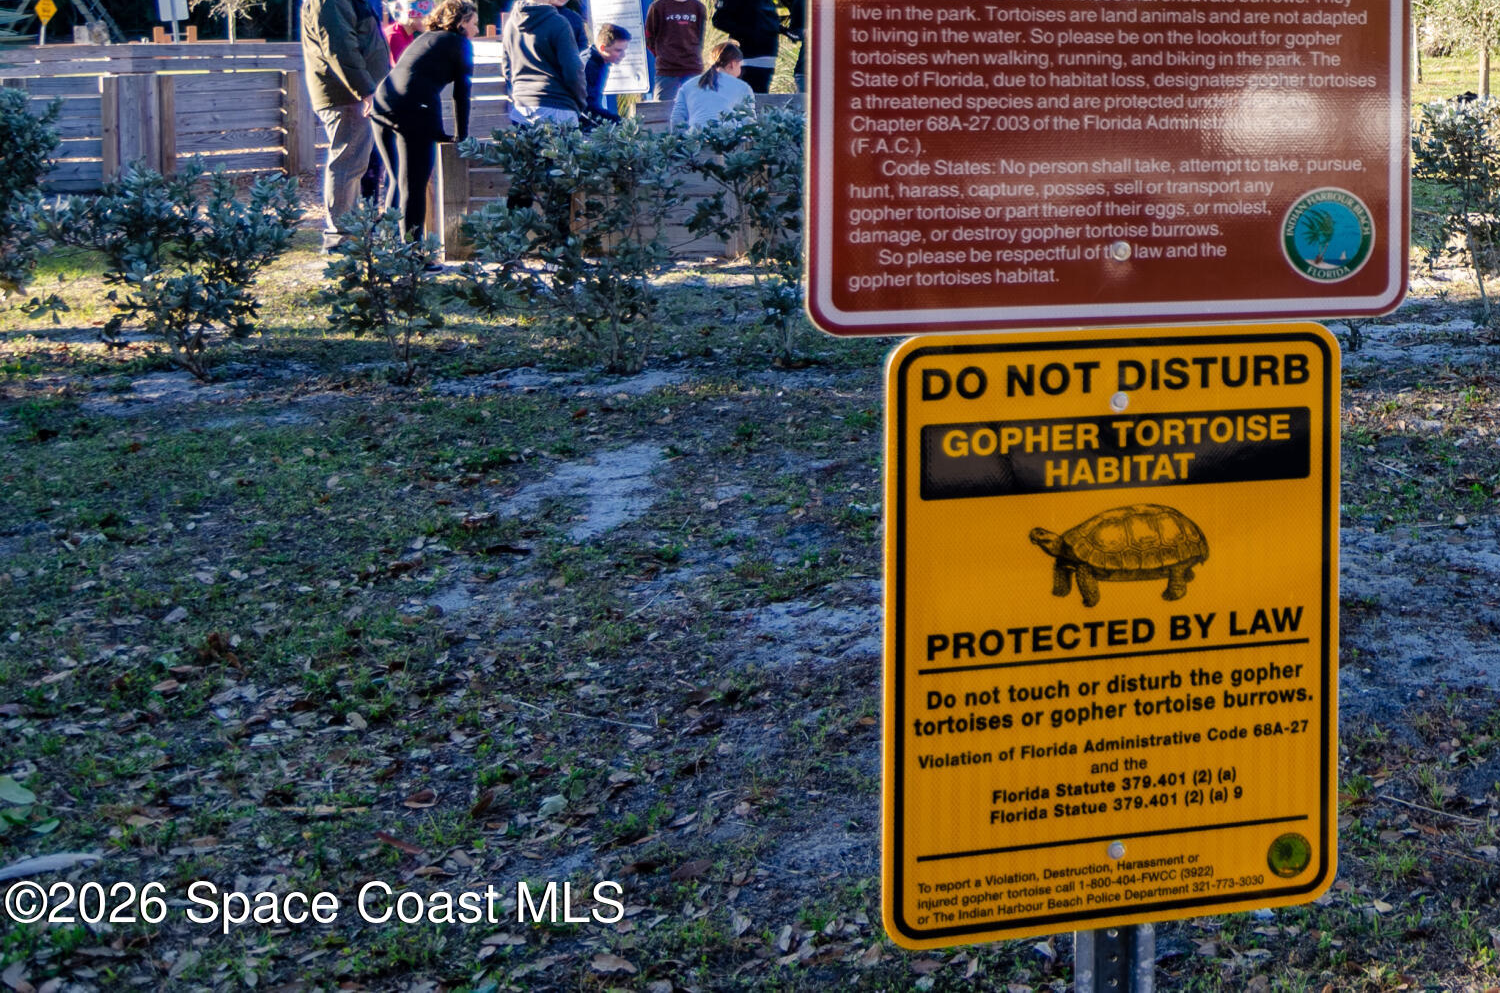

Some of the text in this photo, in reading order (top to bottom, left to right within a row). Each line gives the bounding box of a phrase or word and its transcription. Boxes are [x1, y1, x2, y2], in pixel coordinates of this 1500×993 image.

[849, 267, 1059, 292] gopher tortoises habitat.
[1306, 266, 1351, 279] FLORIDA
[922, 354, 1310, 401] DO NOT DISTURB
[943, 415, 1290, 457] GOPHER TORTOISE
[1045, 453, 1195, 487] HABITAT
[927, 607, 1304, 661] PROTECTED BY LAW
[927, 664, 1303, 710] Do not touch or disturb the gopher
[914, 686, 1313, 736] tortoises or gopher tortoise burrows.
[919, 721, 1309, 769] Violation of Florida Administrative Code 68A-27
[1091, 757, 1147, 774] and the
[990, 786, 1243, 825] Florida Statue 379.401 (2) (a) 9
[992, 767, 1237, 804] Florida Statute 379.401 (2) (a)
[918, 866, 1214, 910] injured gopher tortoise call 1-800-404-FWCC (3922)
[919, 884, 931, 895] To
[935, 880, 971, 895] report
[985, 870, 1039, 887] Violation,
[1043, 863, 1112, 881] Destruction,
[1117, 857, 1182, 873] Harassment
[1186, 854, 1200, 864] or
[917, 875, 1264, 925] or The Indian Harbour Beach Police Department 321-773-3030
